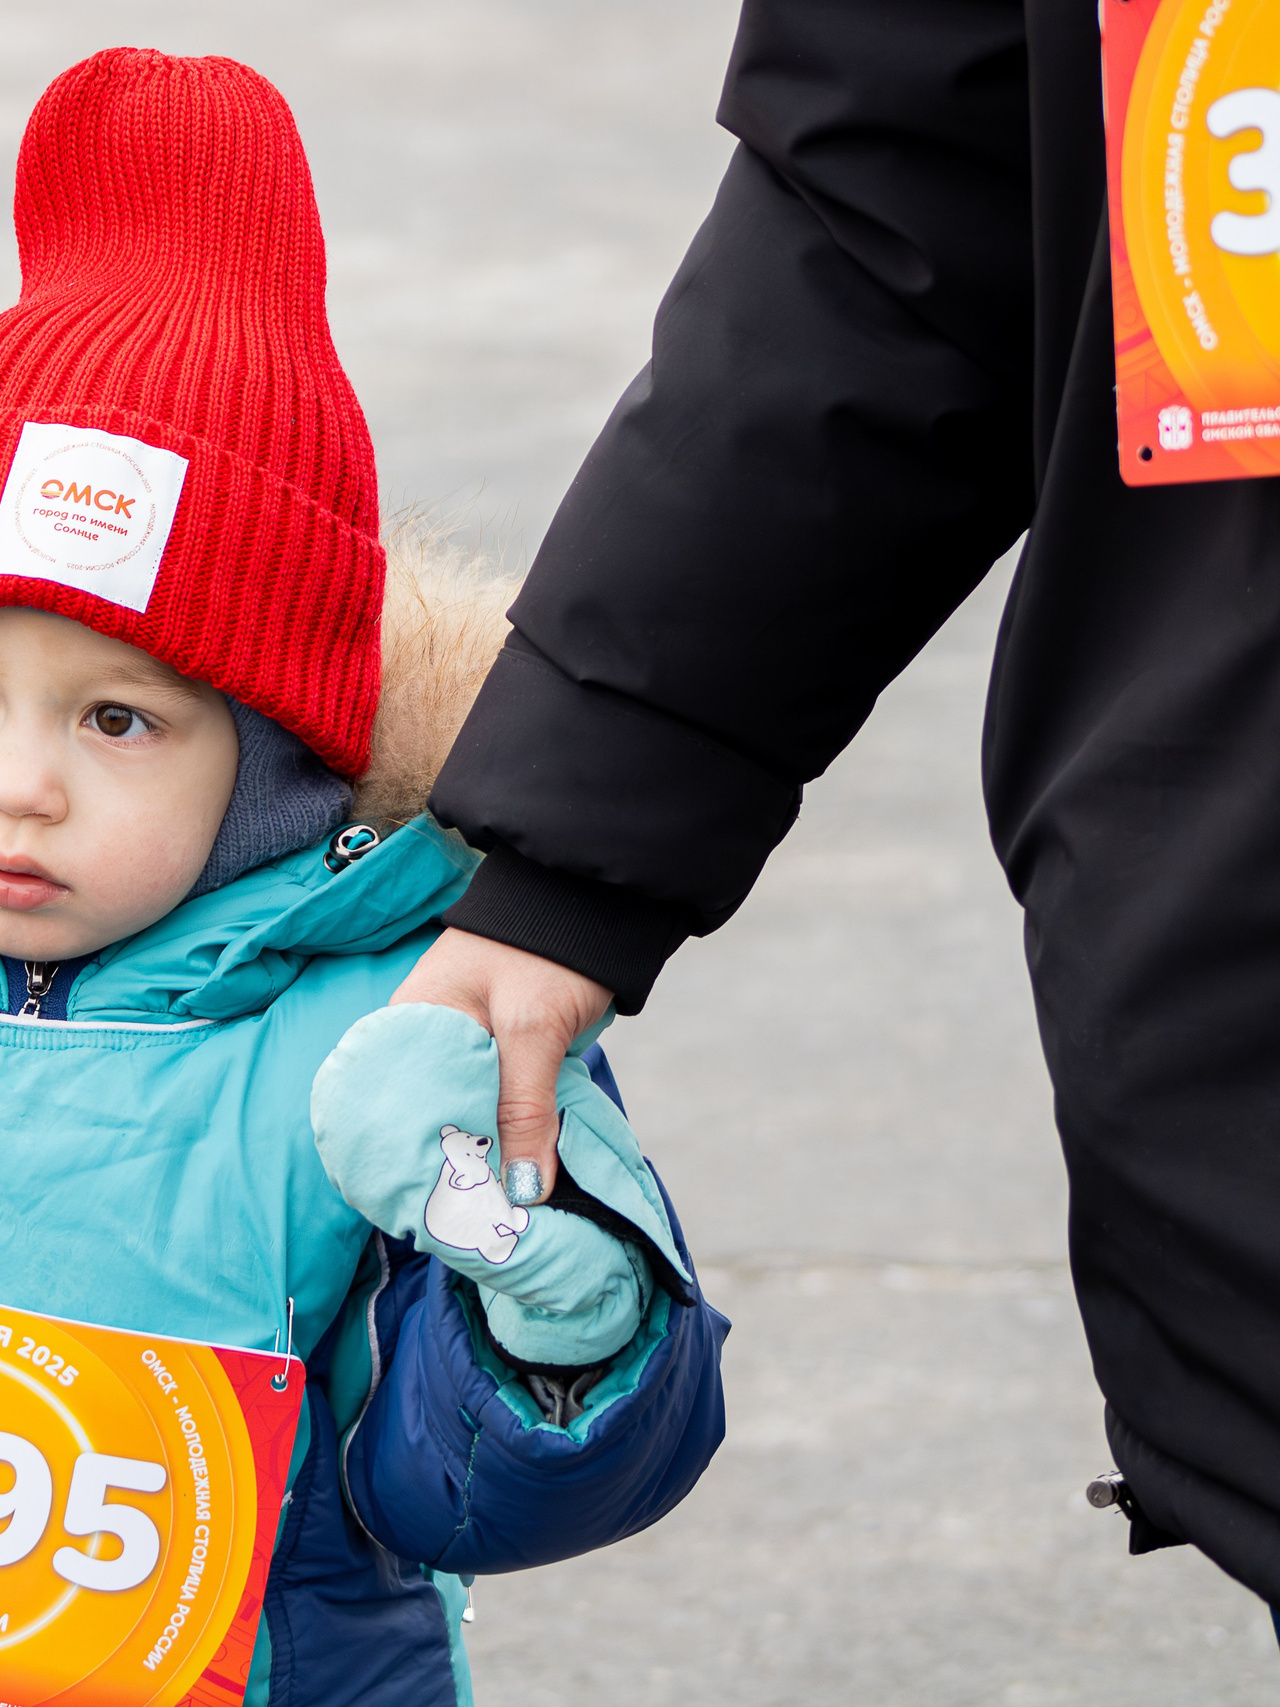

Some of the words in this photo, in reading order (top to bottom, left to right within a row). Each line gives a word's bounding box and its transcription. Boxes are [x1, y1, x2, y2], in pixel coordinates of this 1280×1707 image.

[33, 508, 68, 521] город
[71, 513, 87, 523] по
[90, 518, 128, 536] имени
[40, 479, 136, 519] ОМСК
[53, 522, 99, 541] Солнце
[16, 1336, 80, 1387] 2025
[141, 1349, 179, 1395] ОМСК
[175, 1405, 211, 1521] МОЛОДЕЖНАЯ
[179, 1524, 210, 1600] СТОЛИЦА
[142, 1603, 191, 1671] РОССИИ
